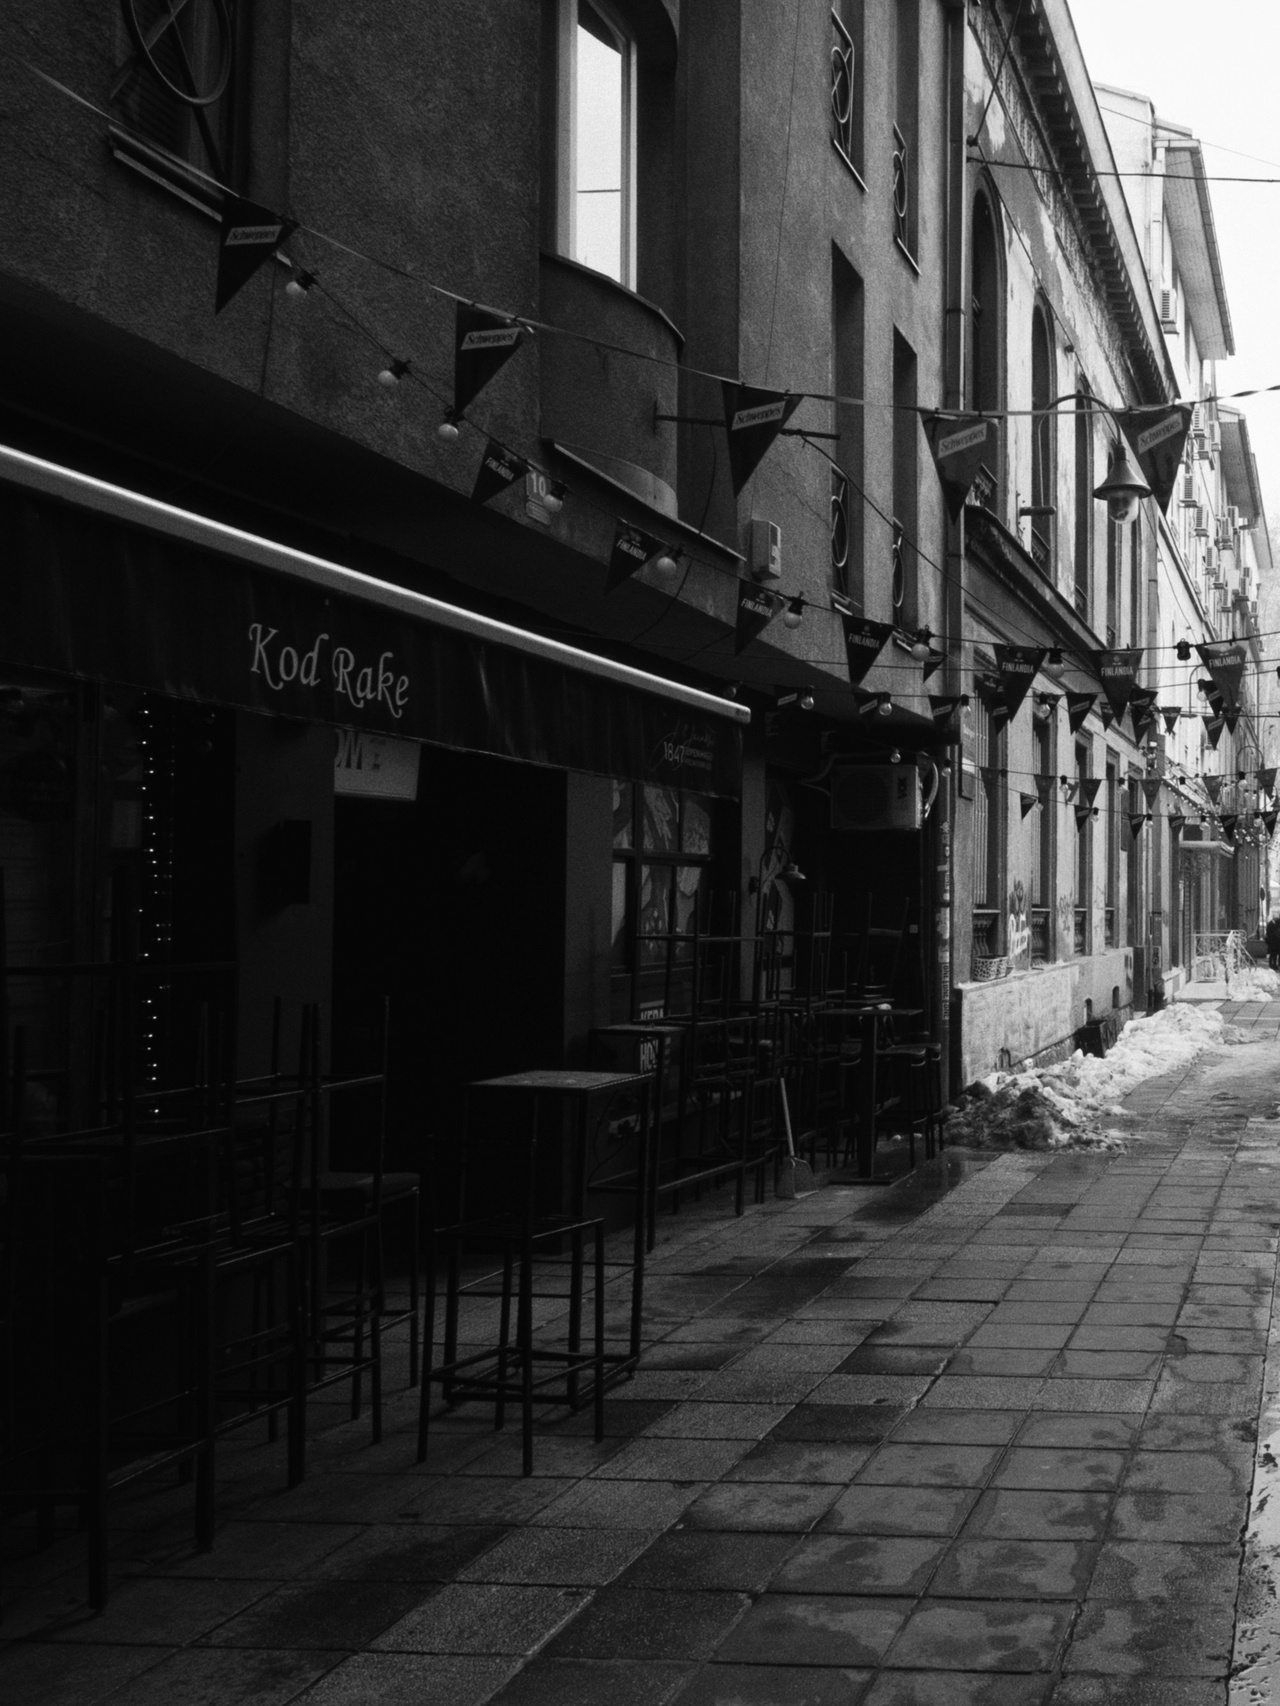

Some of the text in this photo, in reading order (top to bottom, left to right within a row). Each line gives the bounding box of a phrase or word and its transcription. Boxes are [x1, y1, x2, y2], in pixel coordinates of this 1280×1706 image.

[465, 332, 514, 345] Schweppes
[734, 408, 781, 425] Schweppes
[484, 457, 515, 482] FINLANDIA
[531, 471, 547, 499] 10
[616, 539, 647, 561] FINLANDIA
[741, 598, 772, 618] FINLANDIA
[848, 632, 880, 650] FINLANDIA
[248, 622, 409, 719] Kod Rake
[1002, 661, 1035, 674] FINLANDIA
[1100, 665, 1134, 677] FINLANDIA
[1208, 655, 1242, 669] FINLANDIA
[664, 741, 686, 763] 1847
